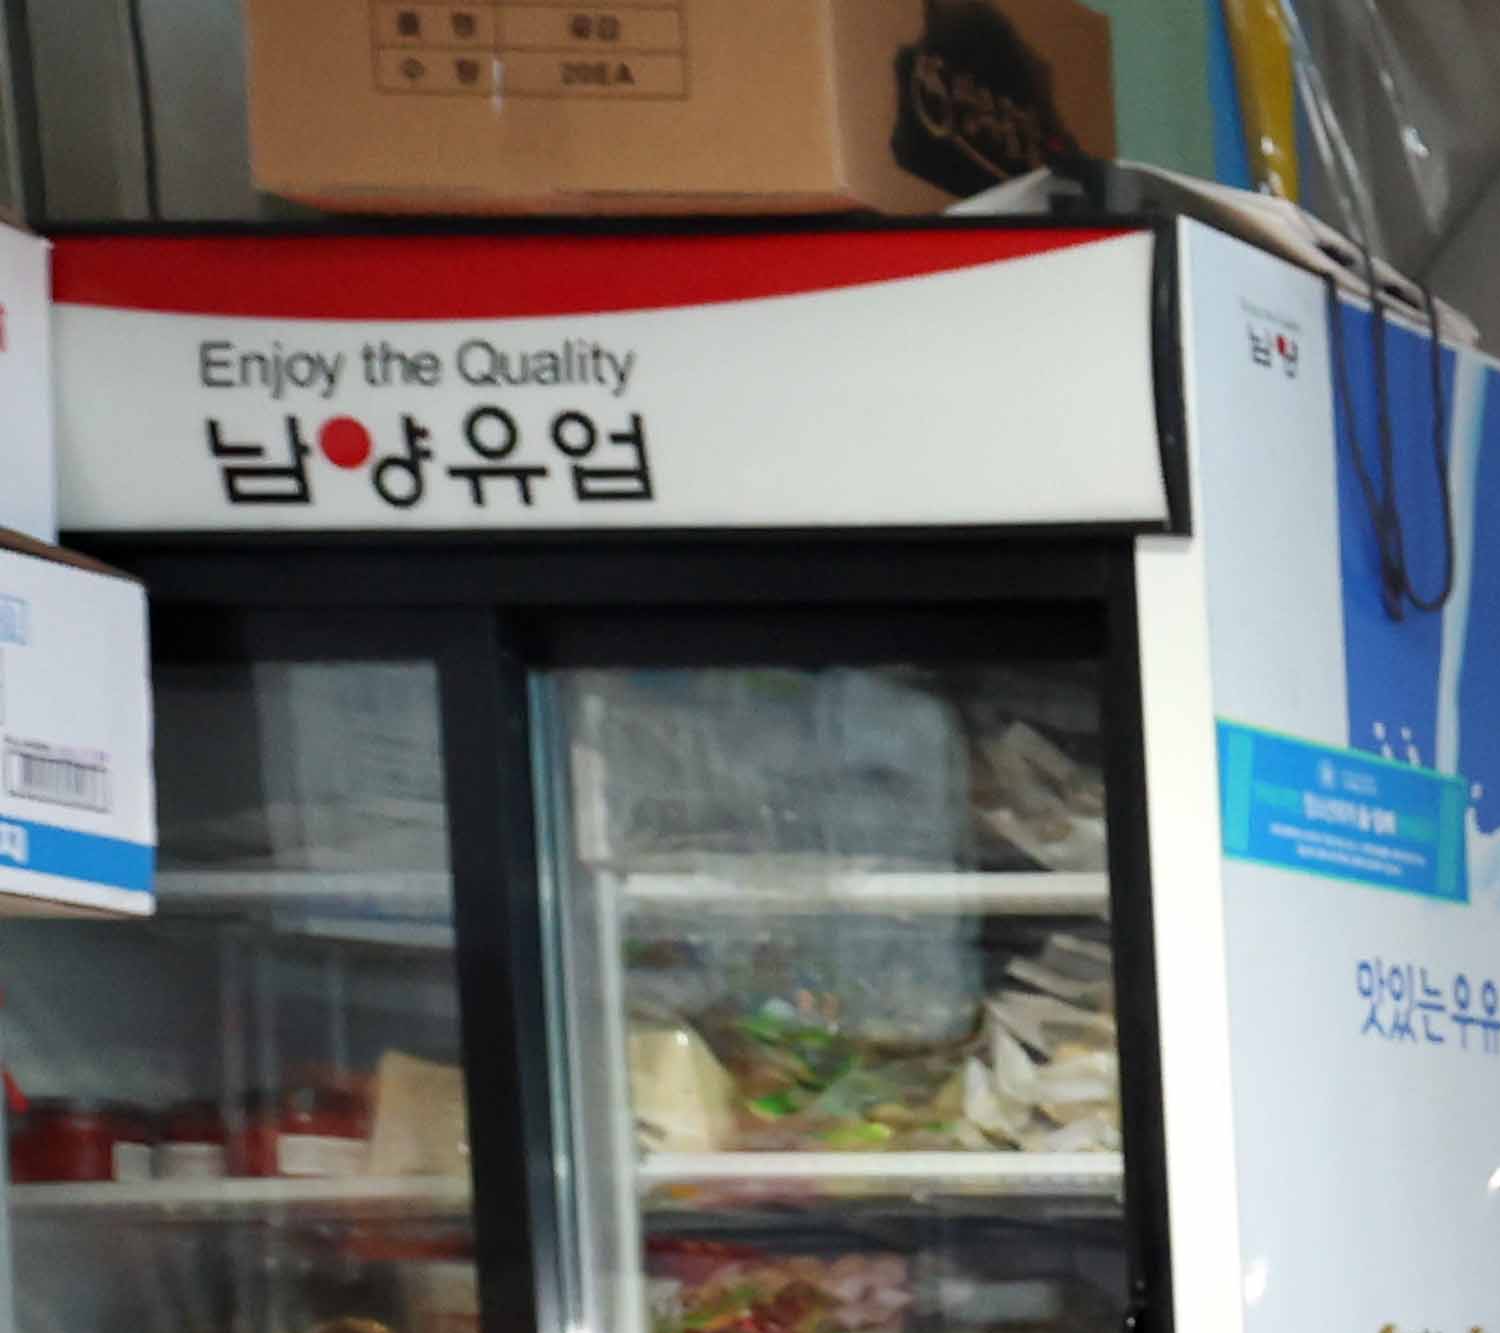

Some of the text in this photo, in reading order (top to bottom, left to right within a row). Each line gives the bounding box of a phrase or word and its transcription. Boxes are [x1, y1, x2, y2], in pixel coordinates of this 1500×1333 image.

[199, 338, 634, 399] Enjoy the Quality
[205, 404, 655, 508] 남양유업
